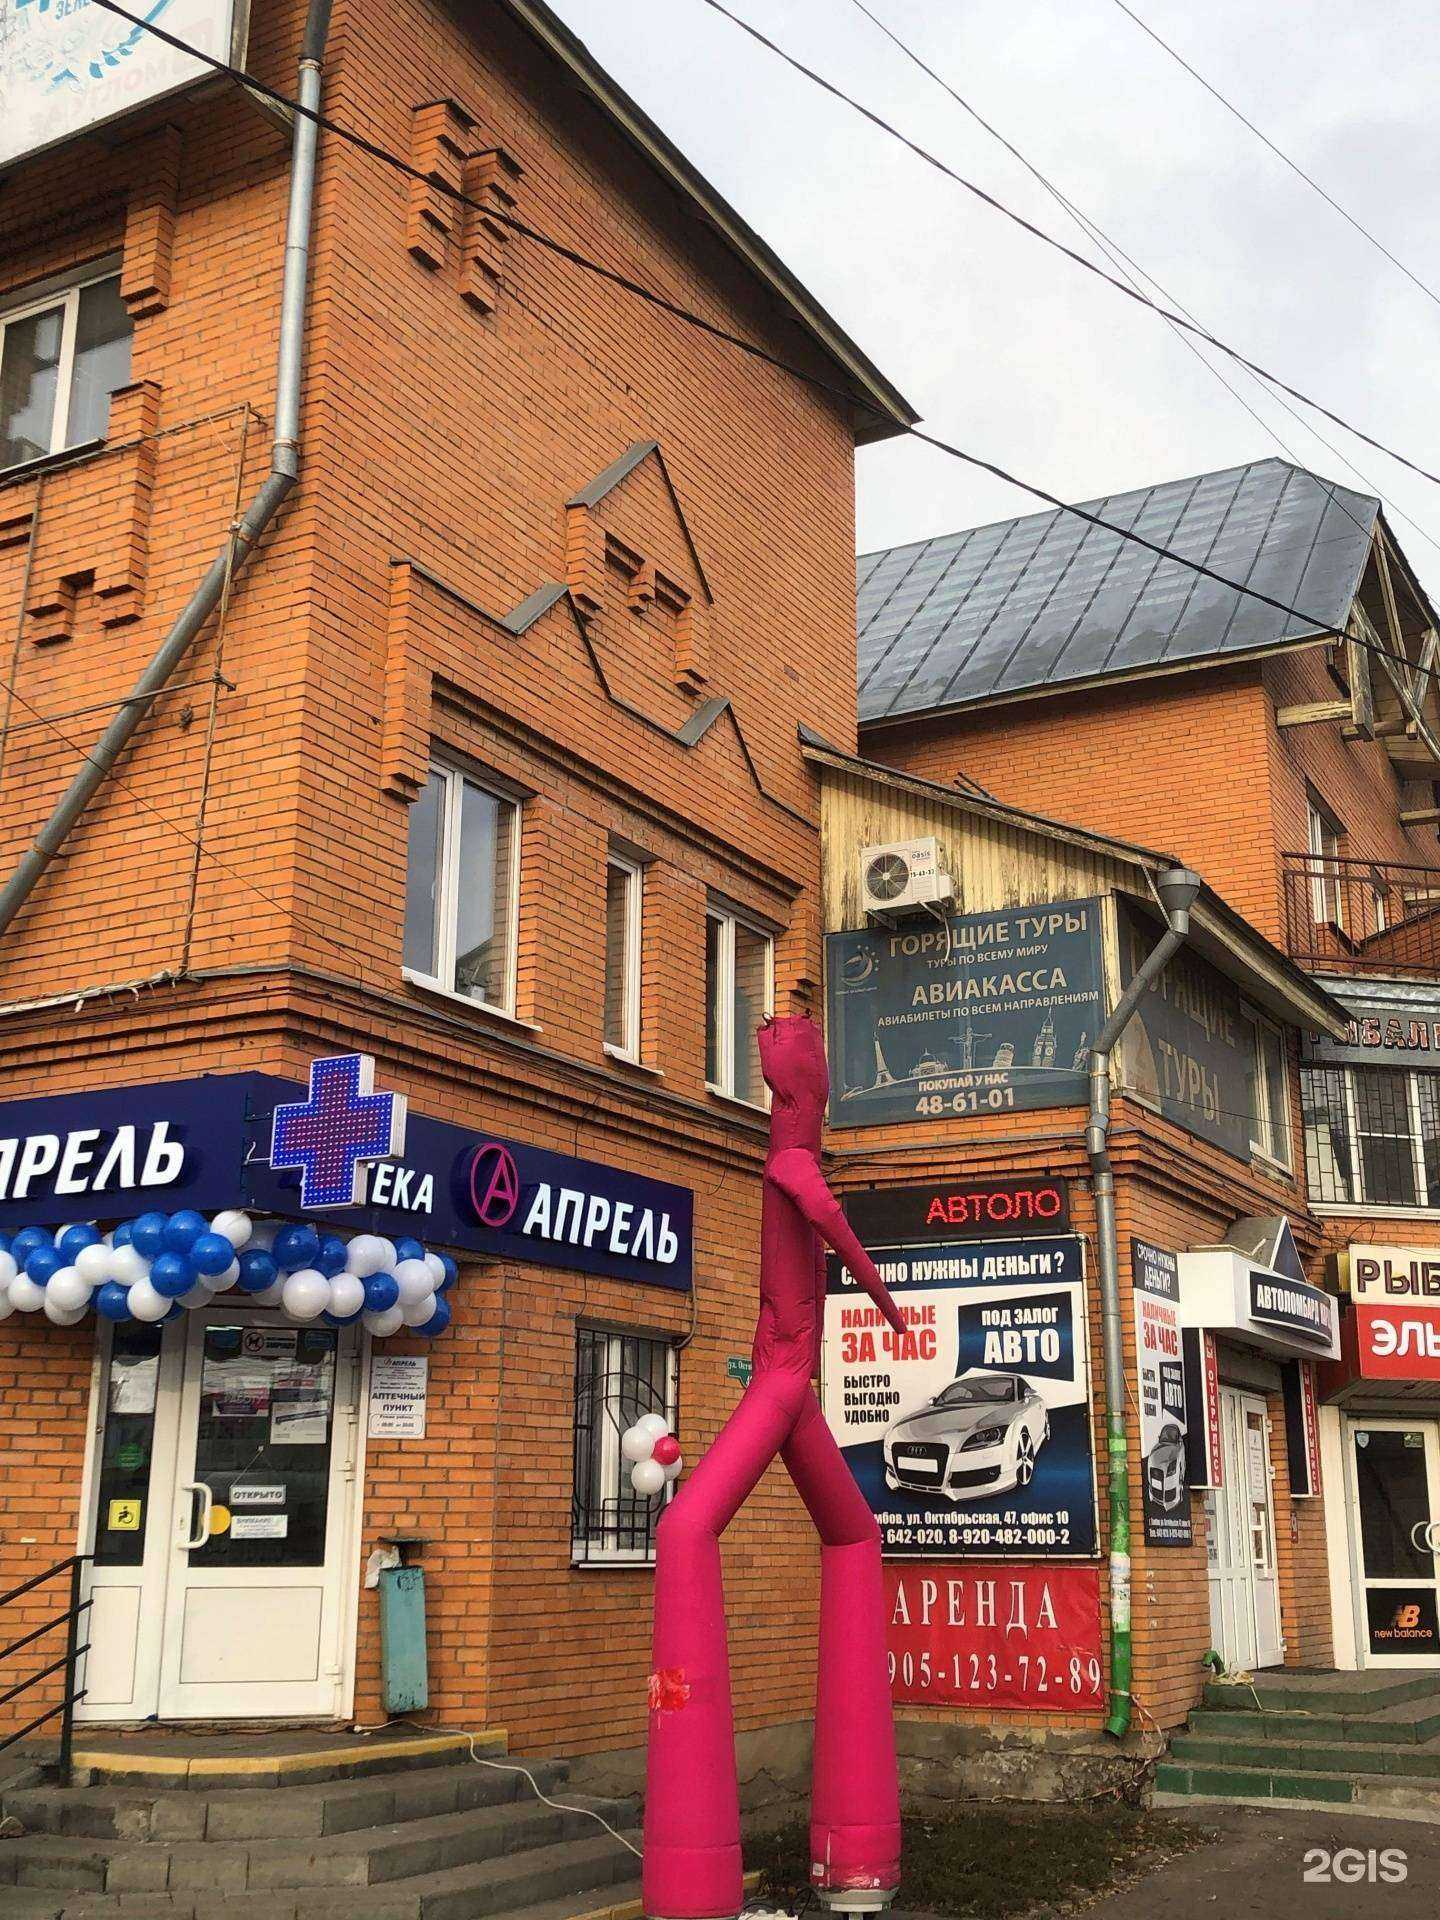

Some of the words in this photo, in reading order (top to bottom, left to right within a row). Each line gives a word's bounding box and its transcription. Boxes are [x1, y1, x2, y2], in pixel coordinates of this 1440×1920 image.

[889, 921, 1010, 957] ГОРЯЩИЕ
[1015, 910, 1087, 939] ТУРЫ
[927, 958, 956, 969] ТУРЫ
[959, 955, 974, 966] ПО
[977, 949, 1013, 963] ВСЕМУ
[1017, 944, 1048, 957] МИРУ
[912, 967, 1067, 1006] АВИАКАССА
[878, 1009, 950, 1027] АВИАБИЛЕТЫ
[953, 1007, 970, 1018] ПО
[972, 1003, 1002, 1016] ВСЕМ
[1005, 990, 1099, 1011] НАПРАВЛЕНИЯМ
[918, 1075, 973, 1092] ПОКУПАЙ
[975, 1075, 984, 1088] У
[984, 1072, 1009, 1086] НАС
[1158, 1038, 1221, 1126] ТУРЫ
[915, 1087, 1015, 1116] 48-61-01
[367, 1162, 434, 1215] ЕКА
[523, 1183, 679, 1264] АПРЕЛЬ
[927, 1190, 1061, 1225] АВТОЛО
[912, 1257, 978, 1282] НУЖНЫ
[841, 1305, 936, 1328] НАЛИНЫЕ
[982, 1309, 1011, 1327] ПОД
[1014, 1307, 1058, 1325] ЗАЛОГ
[842, 1332, 876, 1363] ЗА
[883, 1329, 937, 1362] ЧАС
[984, 1328, 1060, 1364] АВТО
[1144, 1321, 1158, 1350] ЗА
[1159, 1326, 1178, 1356] ЧАС
[844, 1374, 890, 1389] БЫСТРО
[372, 1392, 426, 1401] АПТЕЧНЫЙ
[844, 1391, 900, 1407] ВЫГОДНО
[1164, 1381, 1182, 1408] АВТО
[383, 1404, 414, 1412] ПУНКТ
[844, 1409, 890, 1425] УДОБНО
[1208, 1370, 1220, 1484] ОТКРЫЛИСЬ
[233, 1491, 283, 1500] ОТКРЫТО
[874, 1511, 905, 1526] мбов,
[906, 1514, 923, 1526] ул.
[925, 1511, 1003, 1526] Октябрьская,
[1004, 1511, 1019, 1526] 47,
[1021, 1510, 1053, 1526] офис
[1056, 1510, 1069, 1525] 10
[887, 1528, 946, 1546] 642-020,
[948, 1528, 1070, 1545] 8-920-482-000-2
[891, 1578, 1059, 1640] АРЕНДА
[1374, 1630, 1393, 1638] new
[1394, 1628, 1433, 1638] balance
